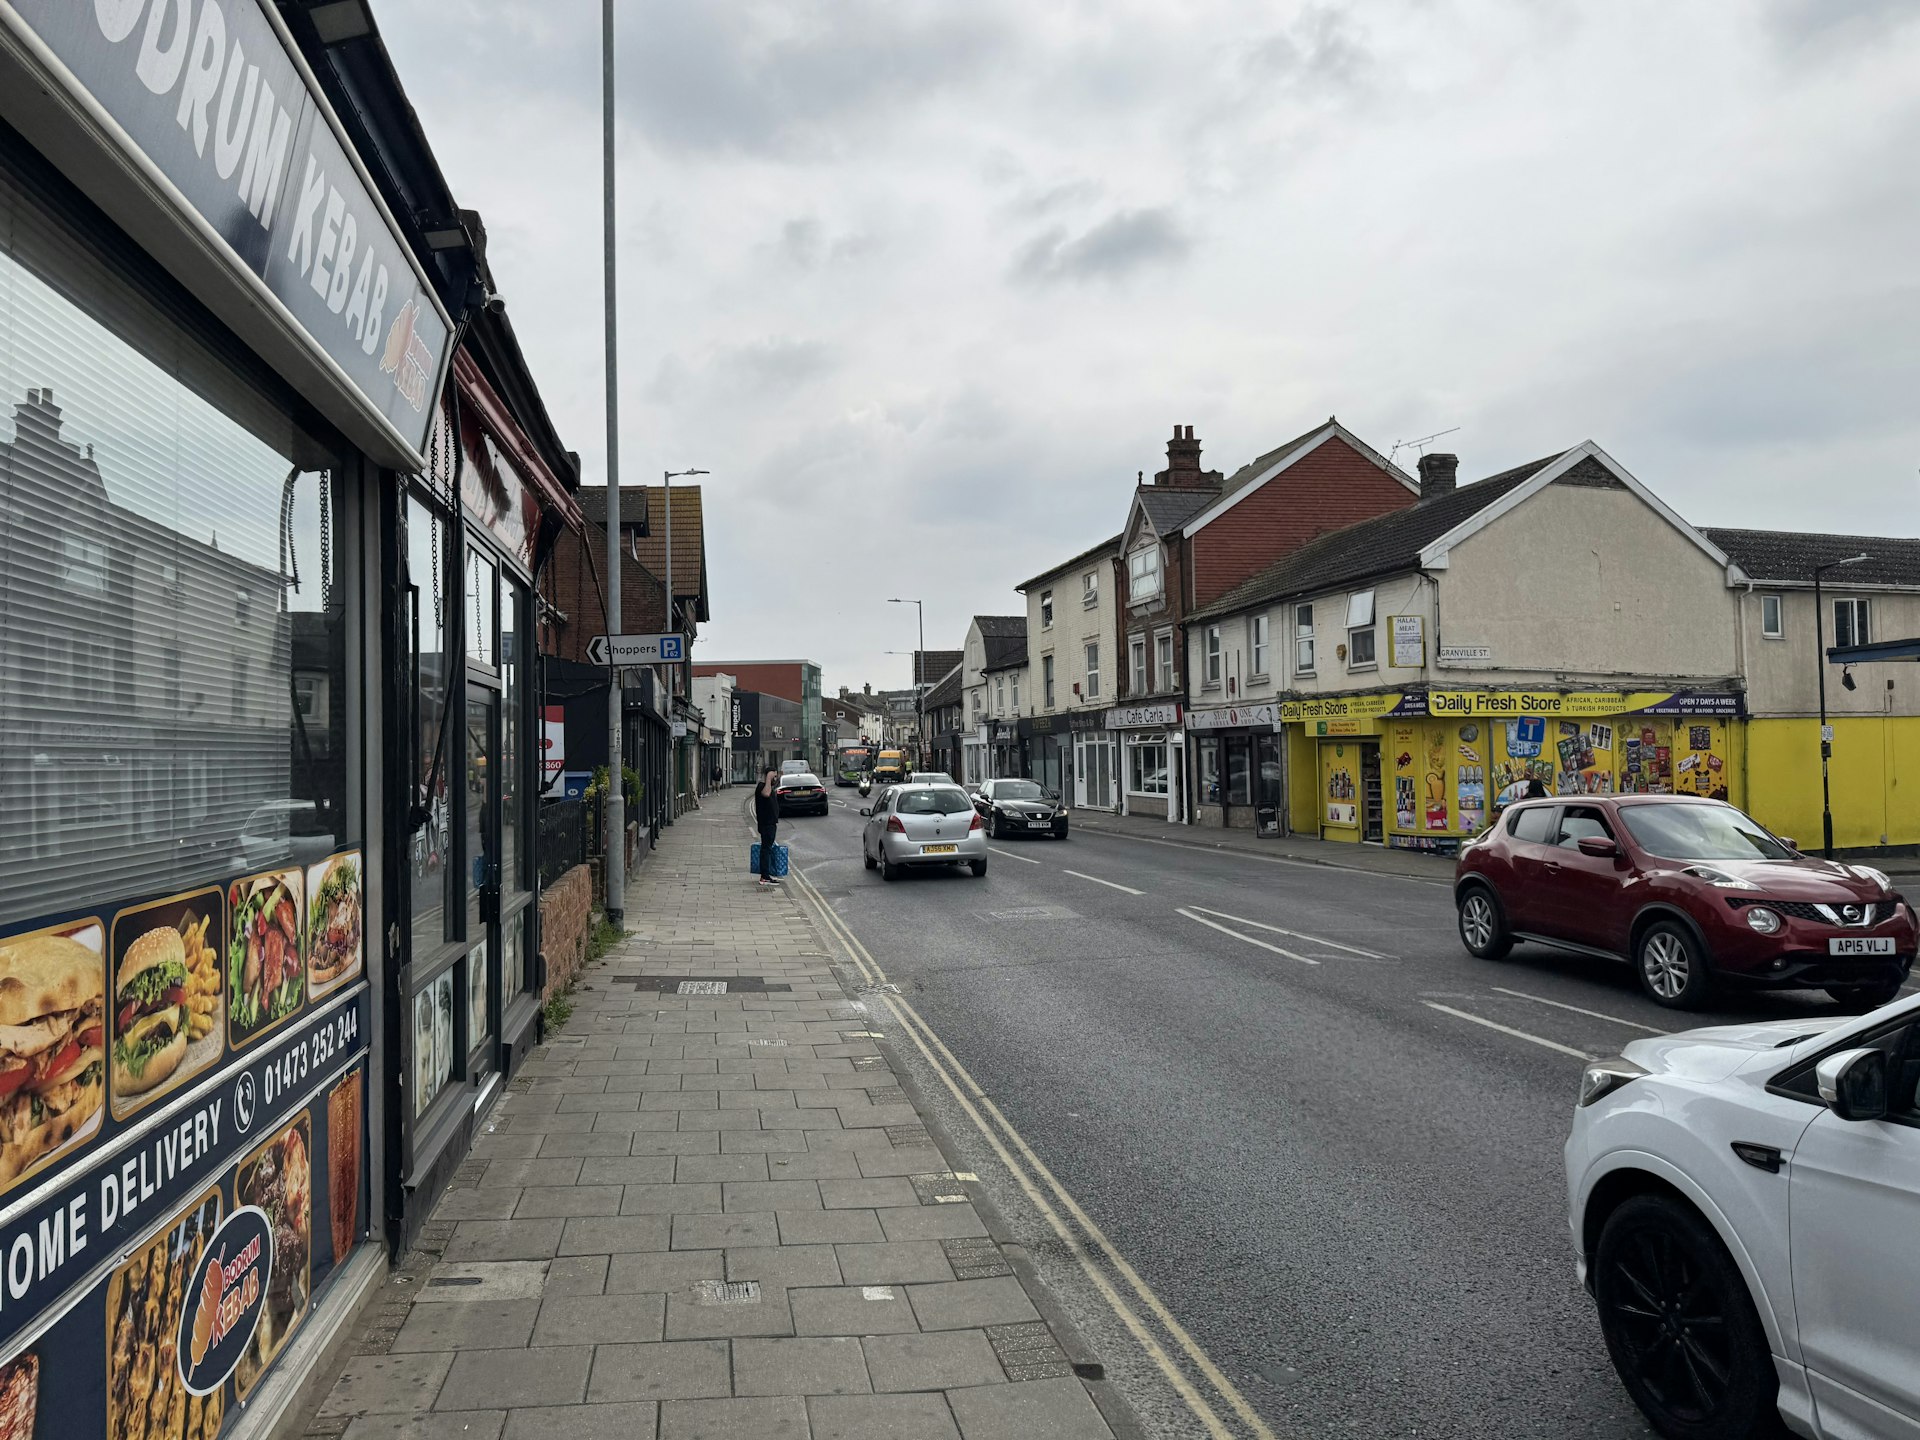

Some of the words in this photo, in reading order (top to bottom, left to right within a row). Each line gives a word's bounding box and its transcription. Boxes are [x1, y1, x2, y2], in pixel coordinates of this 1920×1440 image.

[288, 153, 388, 355] KEBAB
[604, 645, 657, 656] Shoppers
[1213, 710, 1228, 720] STOP
[1239, 708, 1252, 718] ONE
[1283, 704, 1300, 720] Daily
[1302, 703, 1324, 716] Fresh
[1324, 702, 1348, 715] Store
[1436, 695, 1472, 714] Daily
[1476, 694, 1517, 710] Fresh
[1520, 694, 1561, 710] Store
[1126, 709, 1143, 724] Cafe
[1143, 706, 1164, 723] Carla
[1838, 940, 1863, 952] AP15
[1866, 940, 1888, 952] VLJ
[265, 1041, 307, 1104] 01473
[312, 1022, 334, 1069] 252
[338, 1007, 357, 1049] 244
[0, 1192, 87, 1312] OME
[101, 1098, 221, 1233] DELIVERY
[223, 1233, 260, 1292] BODRUM
[212, 1266, 259, 1350] KEBAB
